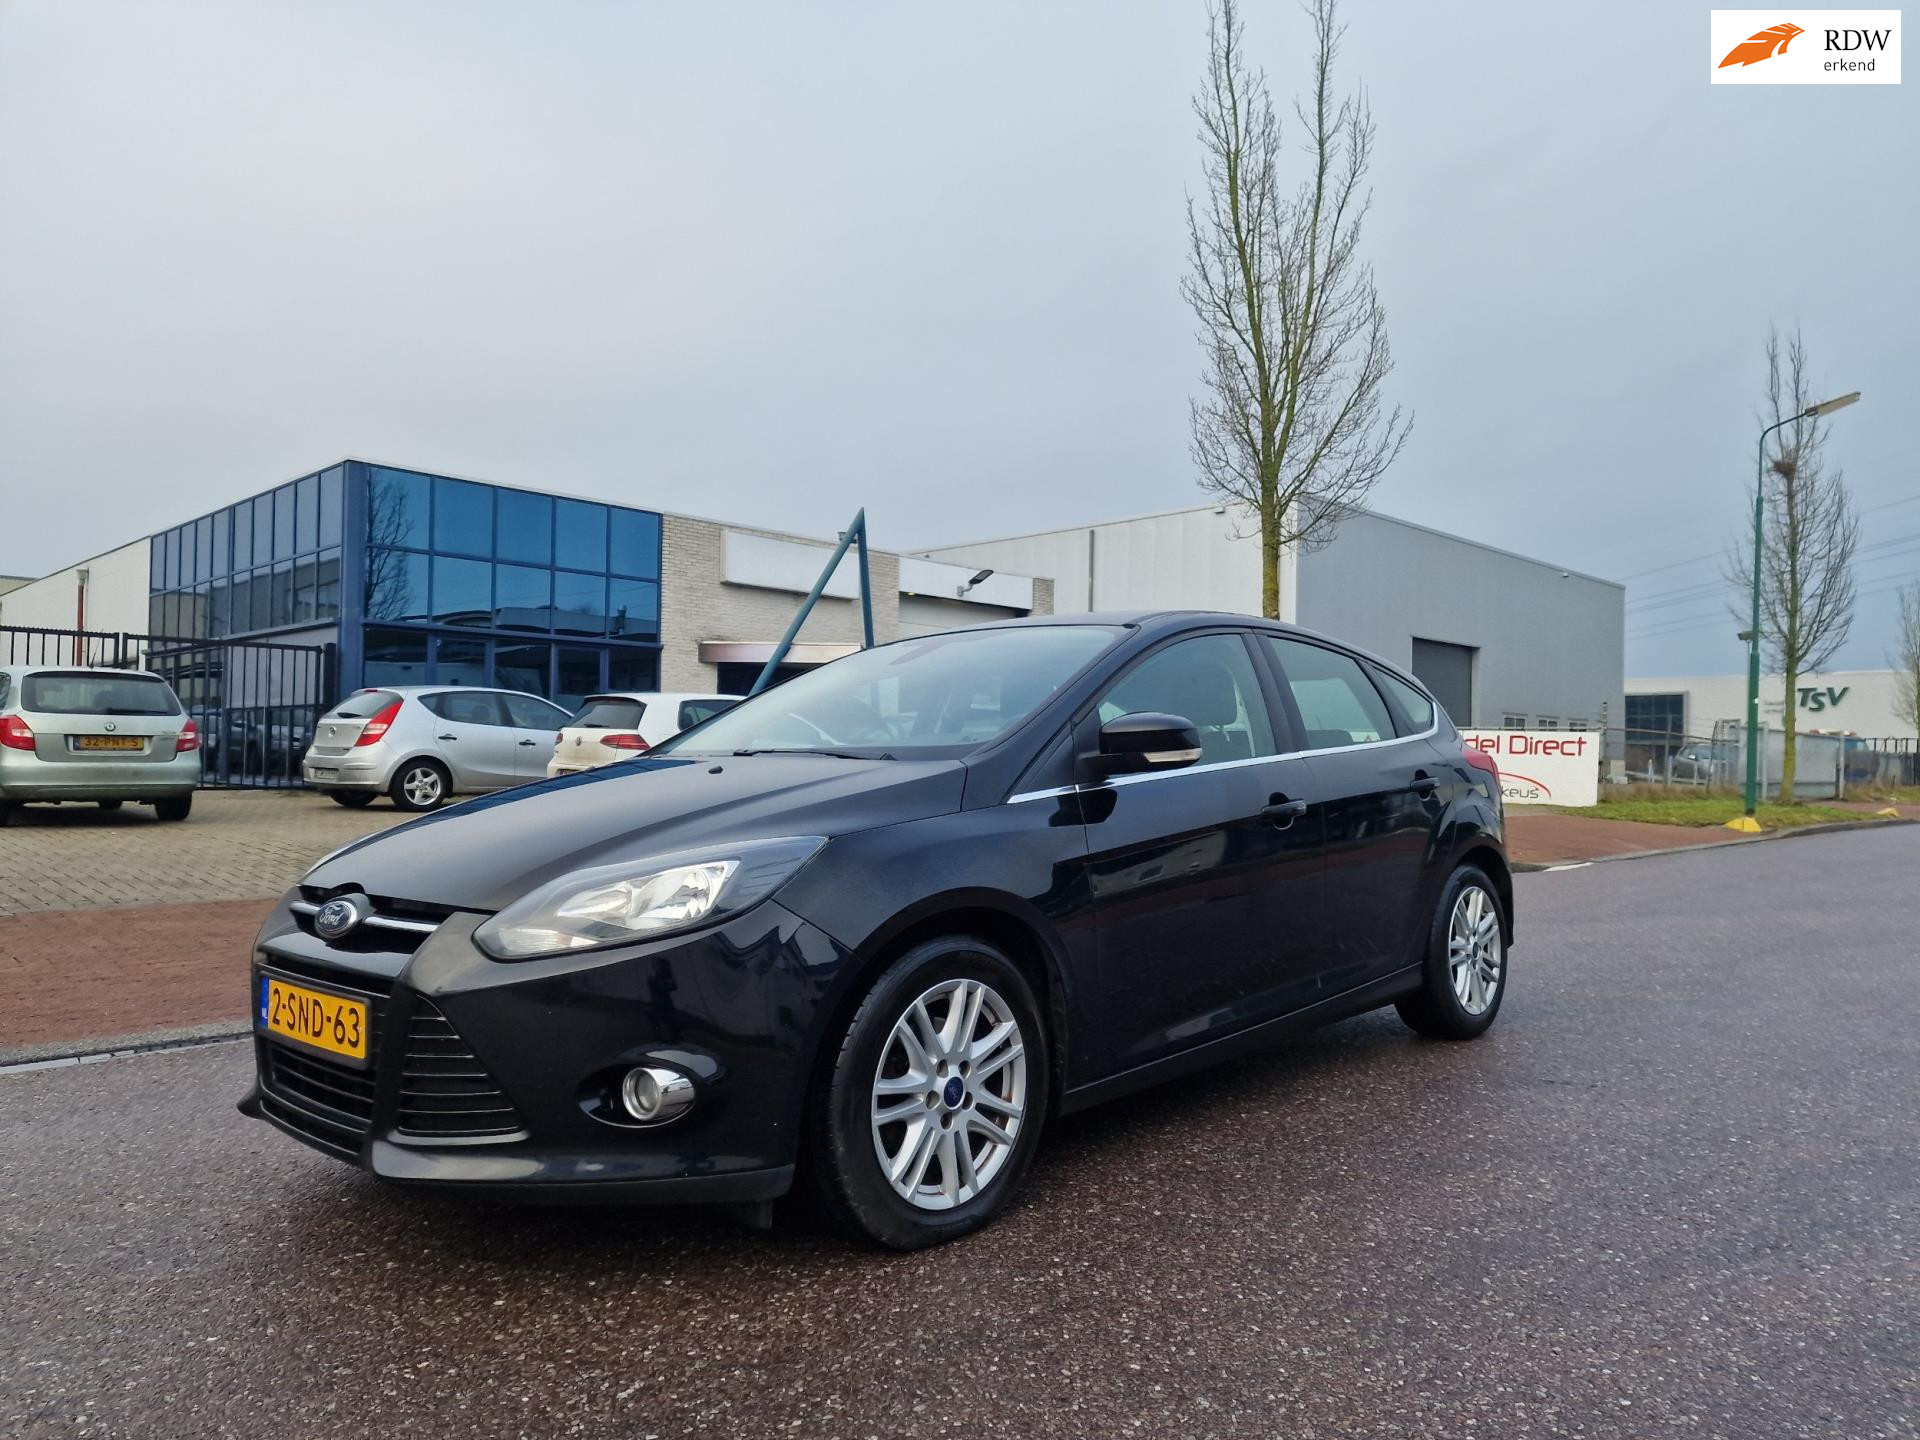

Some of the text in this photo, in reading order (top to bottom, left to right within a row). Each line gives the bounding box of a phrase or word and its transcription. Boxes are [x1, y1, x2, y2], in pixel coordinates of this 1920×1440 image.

[1797, 686, 1850, 712] TSV
[1509, 735, 1587, 756] Direct
[319, 904, 345, 926] Ford
[271, 987, 360, 1049] 2-SND-63
